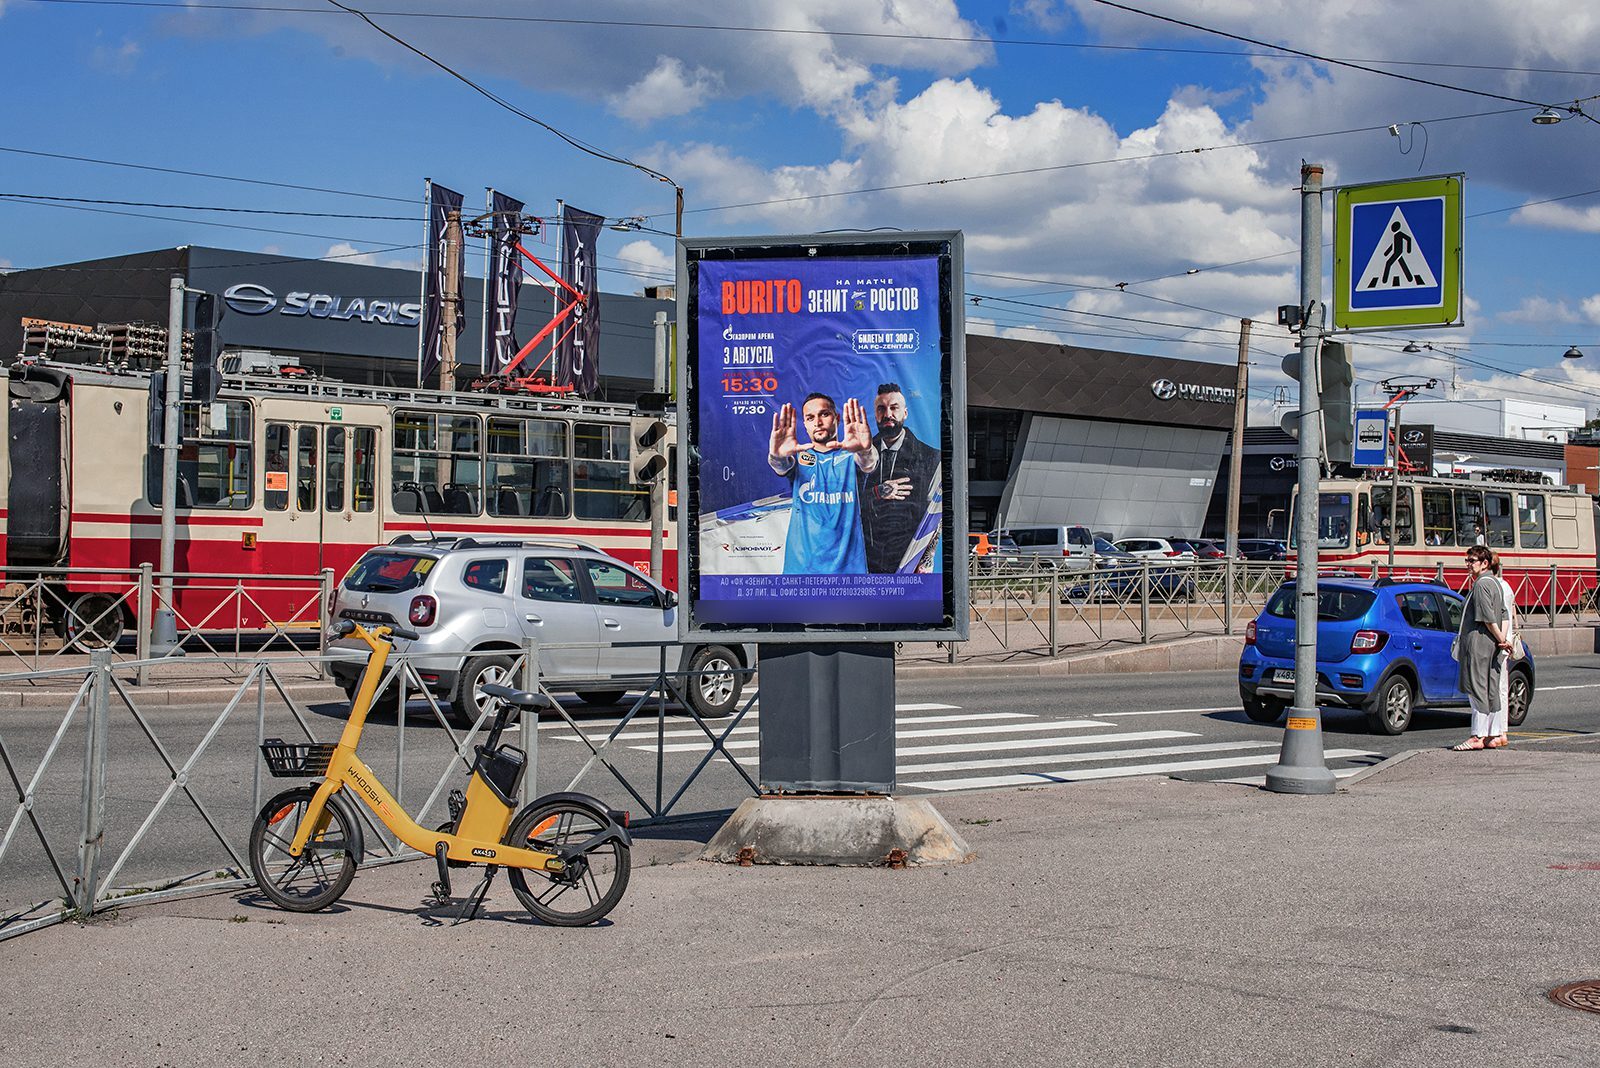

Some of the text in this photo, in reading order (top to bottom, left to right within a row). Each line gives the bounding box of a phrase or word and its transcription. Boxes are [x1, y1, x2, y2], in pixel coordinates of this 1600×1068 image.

[856, 278, 894, 286] МАТЧЕ
[722, 279, 802, 315] BURITO
[808, 287, 919, 314] ЗЕНИТ РОСТОВ
[280, 291, 421, 327] SOLARIS
[858, 333, 885, 344] БИЛЕТЫ
[885, 333, 894, 343] ОТ
[895, 332, 908, 343] 300
[723, 345, 774, 365] 3 АВГУСТА
[721, 377, 778, 393] 15:30
[1178, 383, 1235, 404] HYUNDAI
[732, 405, 766, 415] 17:30
[723, 465, 735, 481] 0+
[720, 577, 729, 586] АО
[854, 576, 895, 585] ПРОФЕССОРА
[745, 587, 754, 597] 37
[779, 587, 798, 597] ОФИС
[799, 587, 810, 597] 831
[811, 587, 828, 597] ОГРН
[348, 766, 383, 806] WHOOSH
